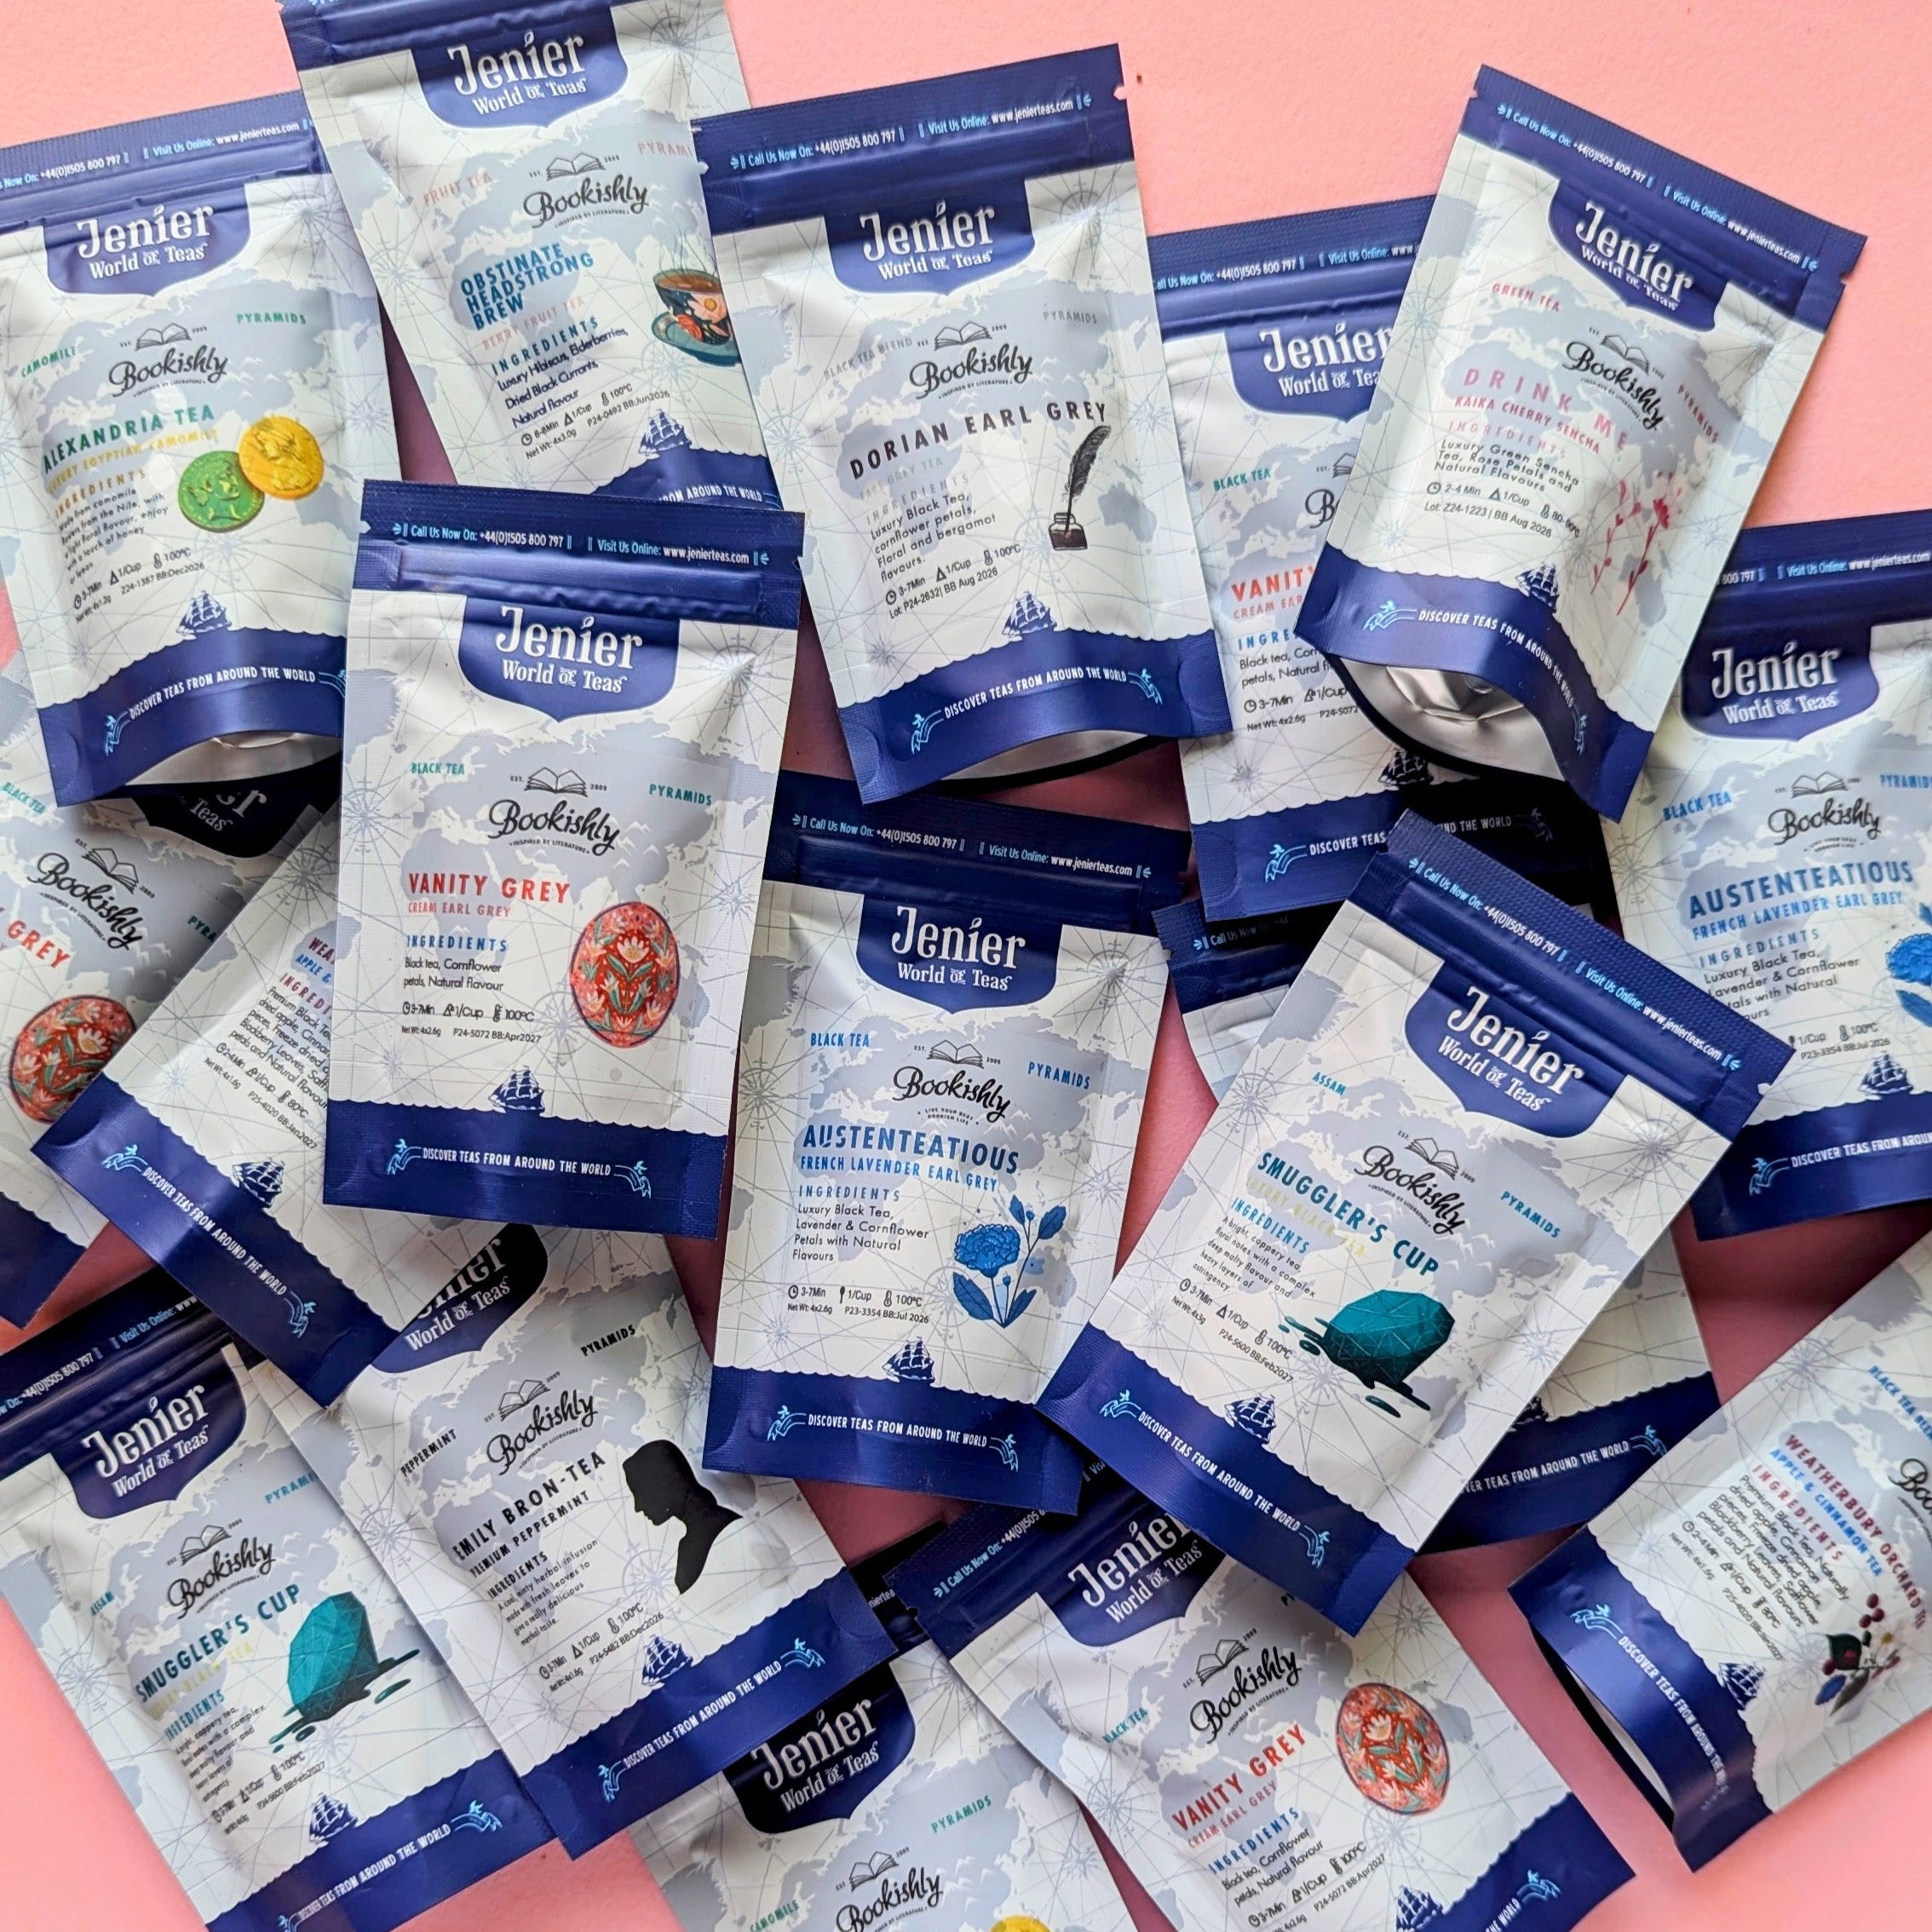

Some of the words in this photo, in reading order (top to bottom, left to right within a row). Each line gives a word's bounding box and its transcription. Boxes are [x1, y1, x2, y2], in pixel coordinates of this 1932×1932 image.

[448, 32, 585, 96] Jenier
[216, 122, 300, 145] www.jenierteas.com
[748, 152, 765, 167] Call
[766, 150, 778, 164] Us
[778, 147, 796, 161] Now
[799, 144, 814, 158] On:
[863, 132, 880, 147] 800
[882, 129, 896, 144] 797
[928, 121, 947, 135] Visit
[949, 118, 960, 132] Us
[961, 114, 989, 130] Online:
[991, 99, 1073, 124] www.jenierteas.com
[423, 182, 462, 207] FRUIT
[468, 173, 493, 190] TEA
[523, 175, 650, 229] Bookishly
[76, 204, 215, 259] Jenier
[860, 200, 995, 262] Jenier
[1575, 199, 1698, 303] Jenier
[1727, 218, 1801, 265] www.jenierteas.com
[89, 251, 139, 280] World
[165, 244, 208, 263] Teas
[460, 242, 564, 296] OBSTINATE
[466, 252, 595, 313] HEADSTRONG
[237, 313, 307, 325] PYRAMIDS
[473, 293, 525, 331] BREW
[1043, 312, 1097, 325] PYRAMIDS
[1492, 283, 1536, 302] GREEN
[1540, 292, 1561, 312] TEA
[21, 346, 78, 378] CAMOMILE
[108, 345, 229, 399] Bookishly
[491, 318, 599, 377] INGREDIENTS
[909, 343, 1033, 401] Bookishly
[1463, 368, 1573, 412] DRINK
[1562, 340, 1665, 431] Bookishly
[43, 414, 164, 474] ALEXANDRIA
[175, 404, 215, 423] TEA
[850, 422, 950, 480] DORIAN
[965, 405, 1032, 435] EARL
[1047, 401, 1107, 423] GREY
[1454, 394, 1496, 411] KAIKA
[1502, 400, 1551, 426] CHERRY
[1555, 419, 1601, 454] SENCHA
[1677, 384, 1718, 444] PYRAMIDS
[1213, 474, 1247, 491] BLACK
[1251, 468, 1272, 482] TEA
[1434, 462, 1485, 478] Natural
[1490, 469, 1545, 492] Flavours
[1440, 439, 1483, 453] Luxury
[1489, 444, 1531, 463] Green
[1534, 458, 1580, 486] Sencha
[871, 515, 903, 541] Luxury
[906, 500, 939, 522] Black
[944, 493, 970, 510] Tea,
[937, 514, 997, 541] bergamot
[411, 526, 428, 538] Call
[429, 526, 441, 540] Us
[442, 527, 462, 540] Now
[463, 529, 478, 542] On:
[529, 533, 547, 547] 800
[548, 535, 564, 548] 797
[597, 539, 618, 553] Visit
[619, 541, 630, 555] Us
[631, 543, 662, 557] Online:
[663, 545, 750, 566] www.jenierteas.com
[495, 605, 643, 670] Jenier
[129, 693, 163, 720] DISCOVER
[164, 683, 185, 702] TEAS
[187, 675, 213, 692] FROM
[217, 668, 257, 684] AROUND
[262, 667, 279, 679] THE
[283, 669, 316, 682] WORLD
[502, 659, 554, 686] World
[583, 670, 628, 694] Teas
[1711, 640, 1842, 699] Jenier
[411, 762, 442, 775] BLACK
[446, 762, 466, 775] TEA
[648, 784, 714, 806] PYRAMIDS
[488, 798, 621, 858] Bookishly
[1308, 837, 1359, 857] DISCOVER
[1361, 831, 1386, 848] TEAS
[1768, 798, 1882, 846] Bookishly
[27, 853, 144, 951] Bookishly
[408, 872, 489, 897] VANITY
[501, 877, 571, 904] GREY
[408, 901, 438, 914] CREAM
[442, 902, 471, 916] EARL
[477, 904, 511, 917] GREY
[1688, 860, 1914, 920] AUSTENTEATIOUS
[7, 919, 72, 969] GREY
[406, 935, 508, 952] INGREDIENTS
[891, 905, 1026, 970] Jenier
[443, 957, 503, 973] Cornflower
[897, 962, 946, 985] World
[972, 969, 1013, 992] Teas
[810, 1032, 845, 1048] BLACK
[848, 1033, 870, 1047] TEA
[1446, 985, 1585, 1096] Jenier
[1642, 1001, 1724, 1061] www.jenierteas.com
[893, 1066, 1011, 1123] Bookishly
[1027, 1061, 1091, 1090] PYRAMIDS
[1312, 1072, 1346, 1096] ASSAM
[1437, 1034, 1488, 1078] World
[1506, 1074, 1550, 1113] Teas
[800, 1155, 845, 1172] FRENCH
[850, 1157, 921, 1177] LAVENDER
[928, 1164, 961, 1184] EARL
[966, 1173, 998, 1193] GREY
[802, 1123, 1019, 1175] AUSTENTEATIOUS
[142, 1166, 177, 1199] DISCOVER
[172, 1191, 194, 1213] TEAS
[189, 1205, 216, 1232] FROM
[797, 1204, 831, 1219] Luxury
[835, 1204, 865, 1216] Black
[868, 1208, 894, 1221] Tea,
[799, 1184, 900, 1202] INGREDIENTS
[1256, 1151, 1390, 1244] SMUGGLER'S
[1392, 1239, 1440, 1277] CUP
[1353, 1145, 1468, 1234] Bookishly
[1500, 1190, 1561, 1239] PYRAMIDS
[794, 1233, 825, 1247] Petals
[827, 1235, 849, 1247] with
[853, 1236, 901, 1252] Natural
[796, 1217, 842, 1231] Lavender
[845, 1219, 854, 1230] &
[858, 1220, 929, 1239] Cornflower
[1230, 1197, 1310, 1255] INGREDIENTS
[792, 1249, 835, 1262] Flavours
[580, 1324, 636, 1358] PYRAMIDS
[908, 1313, 929, 1324] 2026
[81, 1383, 209, 1479] Jenier
[400, 1429, 458, 1477] PEPPERMINT
[486, 1389, 598, 1476] Bookishly
[452, 1520, 497, 1561] EMILY
[501, 1451, 607, 1524] BRON-TEA
[1216, 1470, 1254, 1500] AROUND
[1253, 1494, 1273, 1515] THE
[1271, 1506, 1301, 1532] WORLD
[1785, 1434, 1883, 1540] WEATHERBURY
[1879, 1542, 1922, 1609] ORCHARD
[1814, 1493, 1868, 1555] CINNAMON
[470, 1544, 510, 1578] PREMIUM
[512, 1490, 591, 1548] PEPPERMINT
[167, 1537, 276, 1619] Bookishly
[135, 1613, 250, 1704] SMUGGLER'S
[256, 1584, 302, 1620] CUP
[1188, 1645, 1302, 1745] Bookishly
[750, 1698, 877, 1790] Jenier
[1172, 1771, 1245, 1831] VANITY
[1248, 1722, 1307, 1778] GREY
[931, 1795, 992, 1834] PYRAMIDS
[1208, 1807, 1300, 1875] INGREDIENTS
